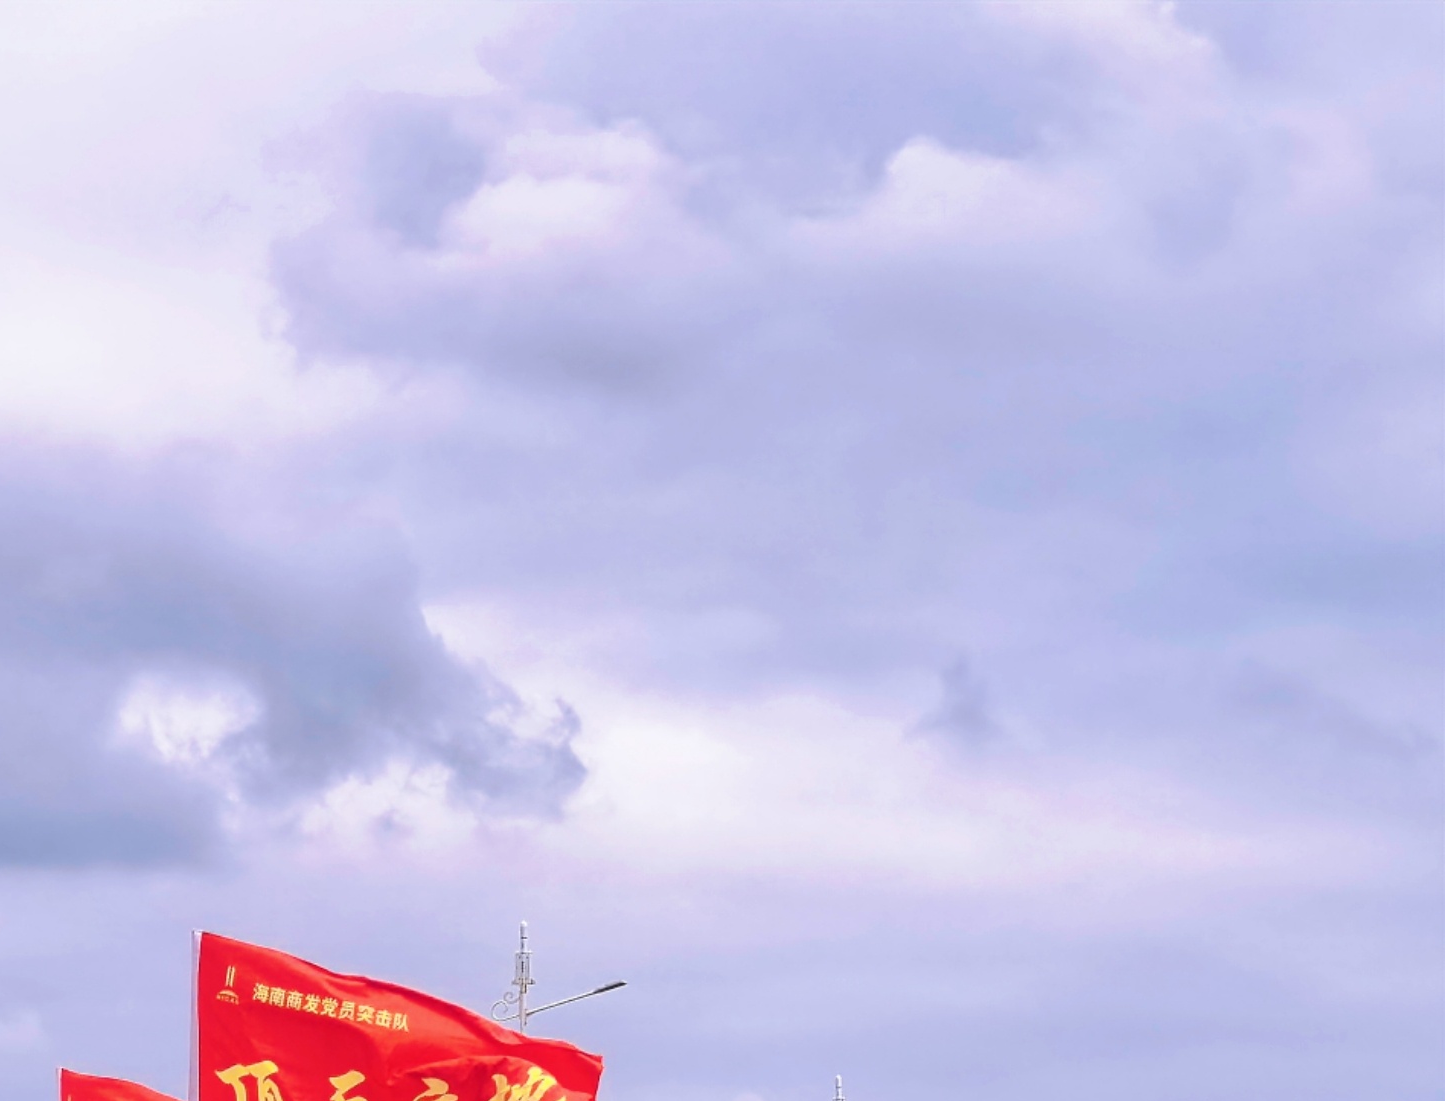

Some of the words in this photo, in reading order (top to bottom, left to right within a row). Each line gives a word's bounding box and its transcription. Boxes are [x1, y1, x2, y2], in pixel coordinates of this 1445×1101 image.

[252, 982, 410, 1033] 海南商发党员突击队
